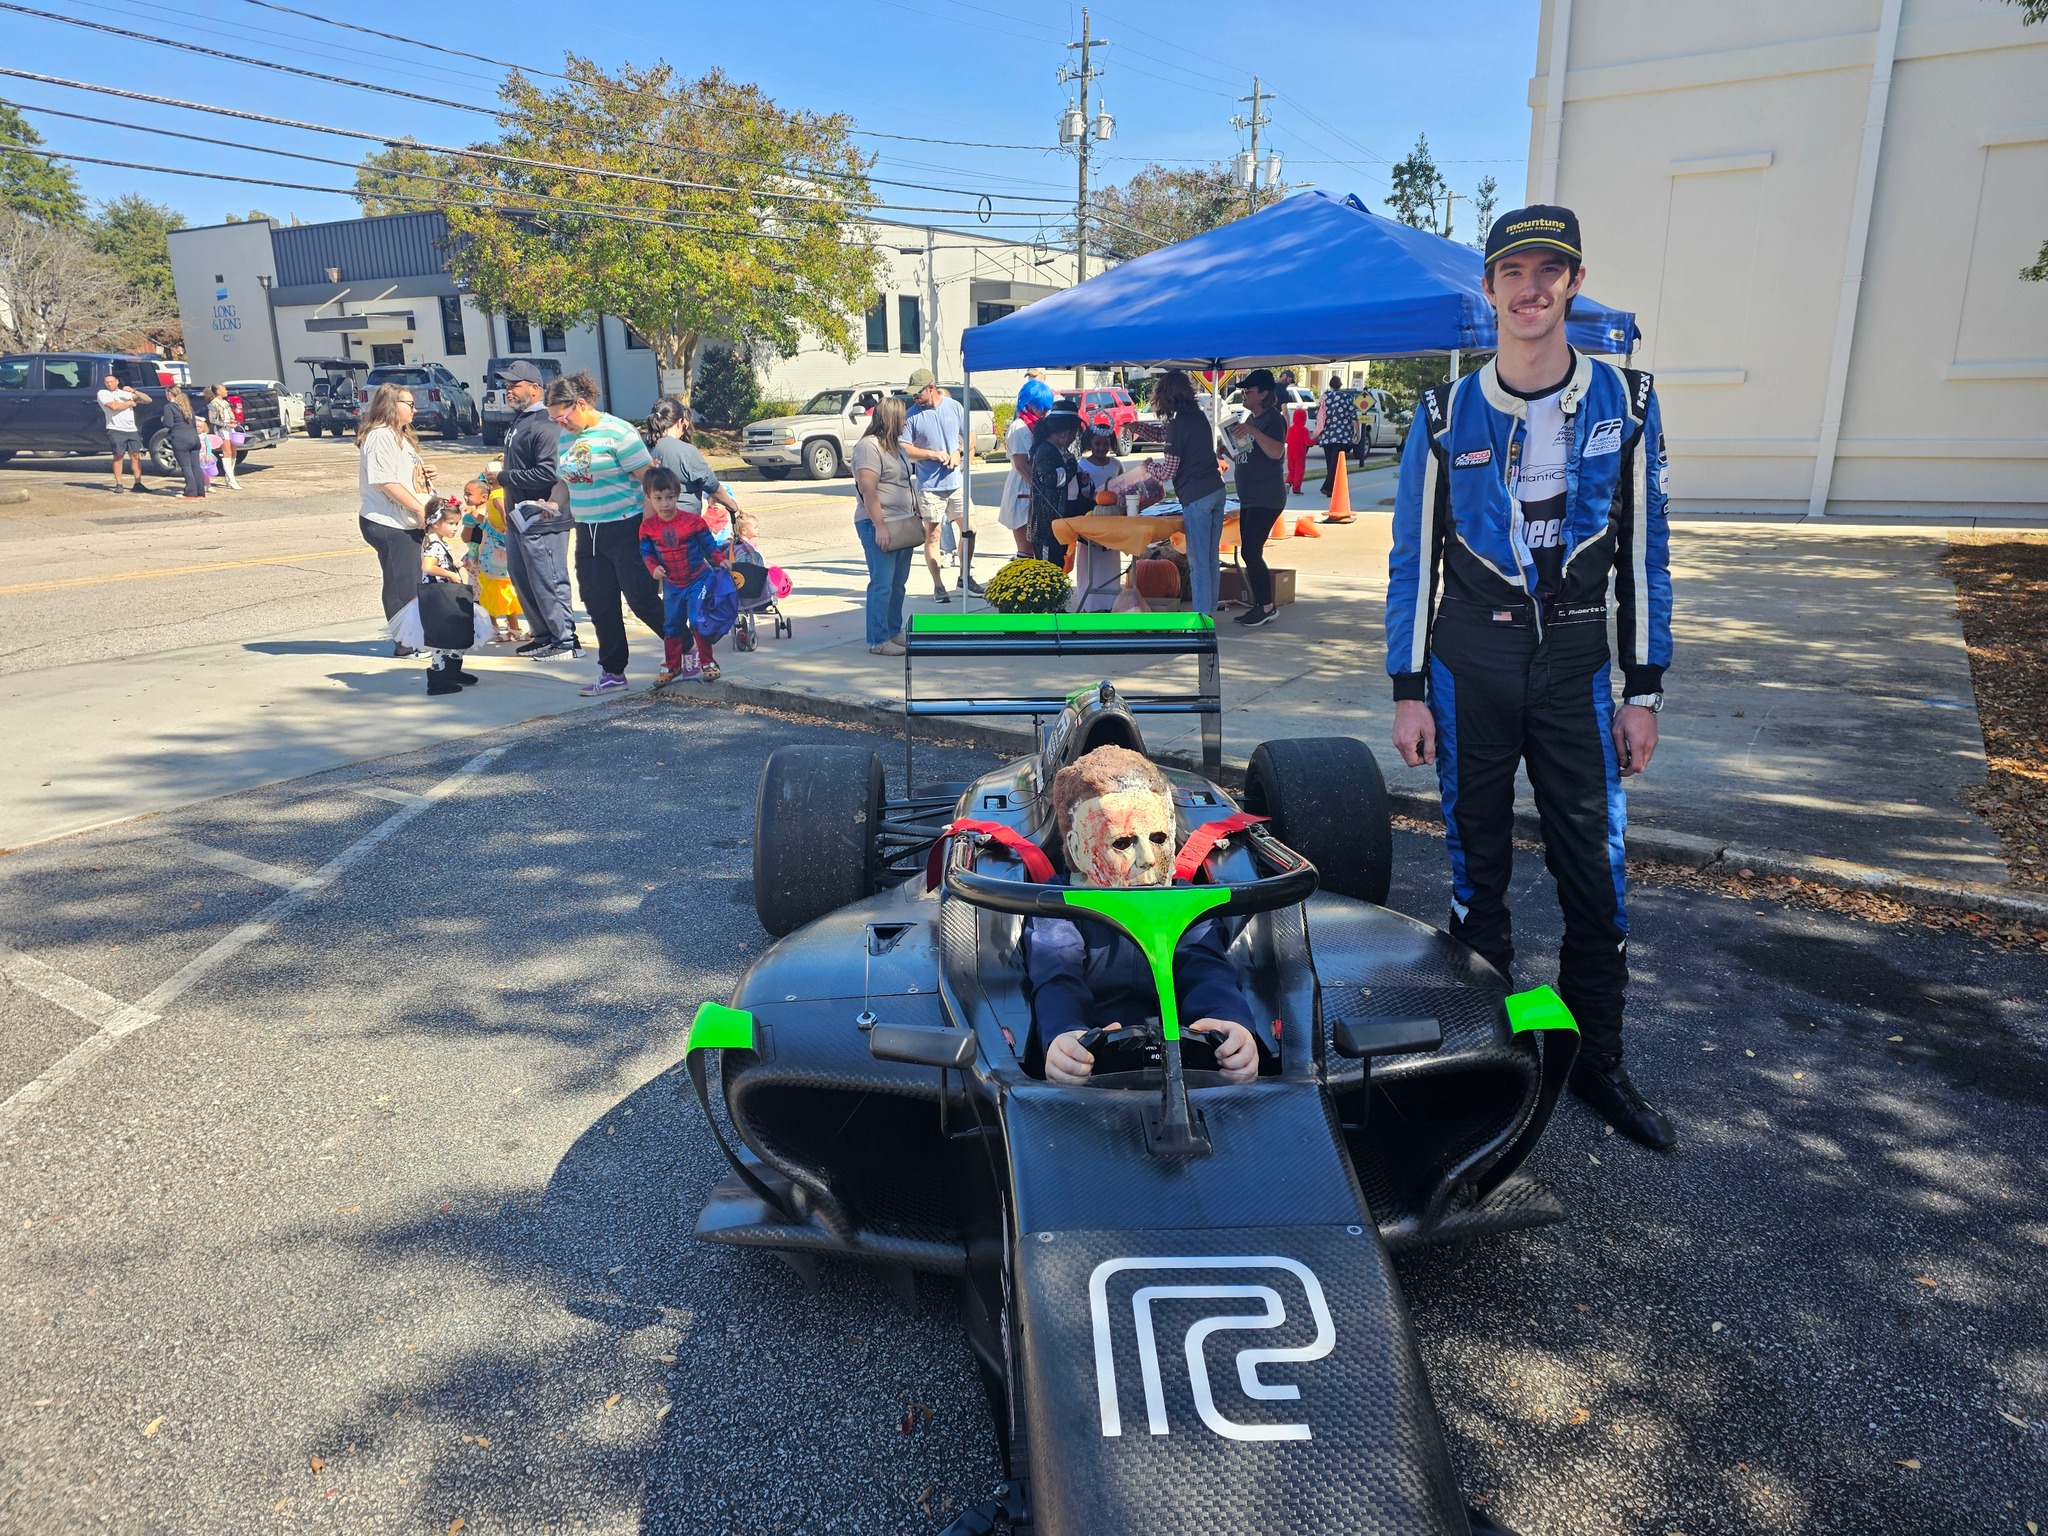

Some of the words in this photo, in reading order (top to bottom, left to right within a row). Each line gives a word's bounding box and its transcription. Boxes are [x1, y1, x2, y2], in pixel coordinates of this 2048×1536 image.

[1506, 218, 1566, 233] mountune
[213, 304, 236, 318] LONG
[1636, 373, 1650, 409] HRX
[1424, 389, 1442, 422] HRX
